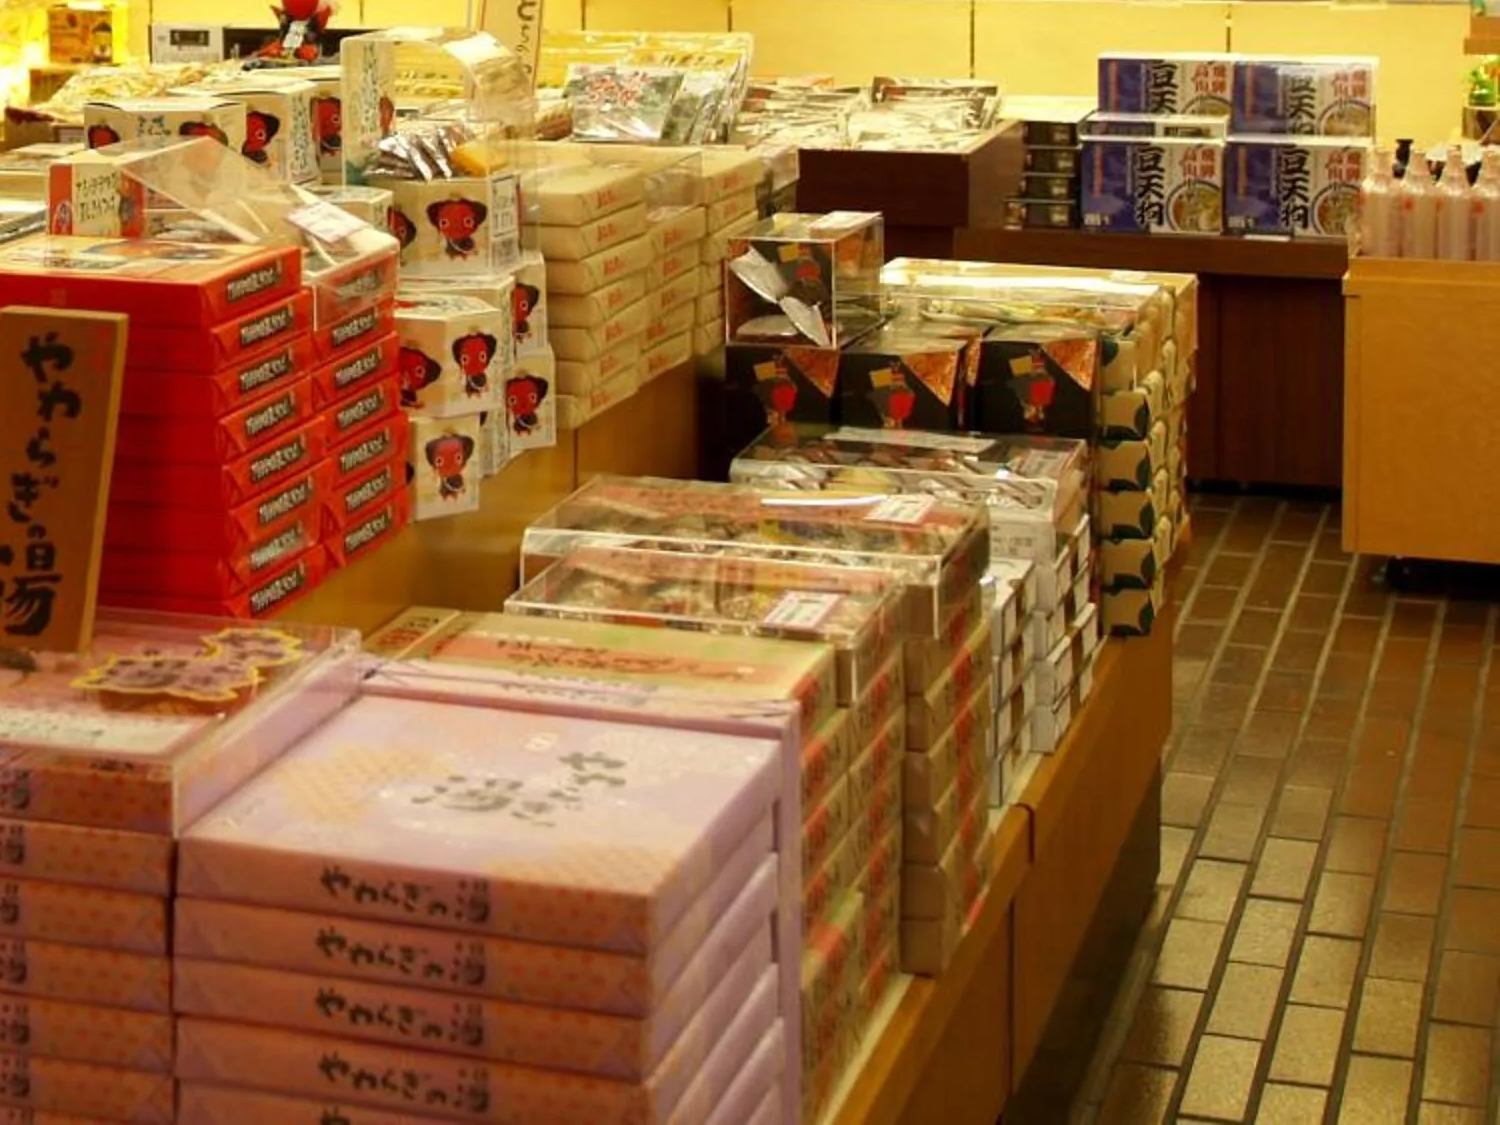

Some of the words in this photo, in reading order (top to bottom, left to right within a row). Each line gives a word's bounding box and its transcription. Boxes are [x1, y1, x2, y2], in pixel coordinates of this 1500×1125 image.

[1136, 144, 1165, 226] 豆天狗
[1281, 146, 1310, 228] 豆天狗
[321, 864, 490, 923] やわらぎの湯
[315, 926, 486, 987] やわらぎの湯
[315, 986, 484, 1047] やわらぎの湯
[318, 1051, 490, 1113] やわらぎの湯
